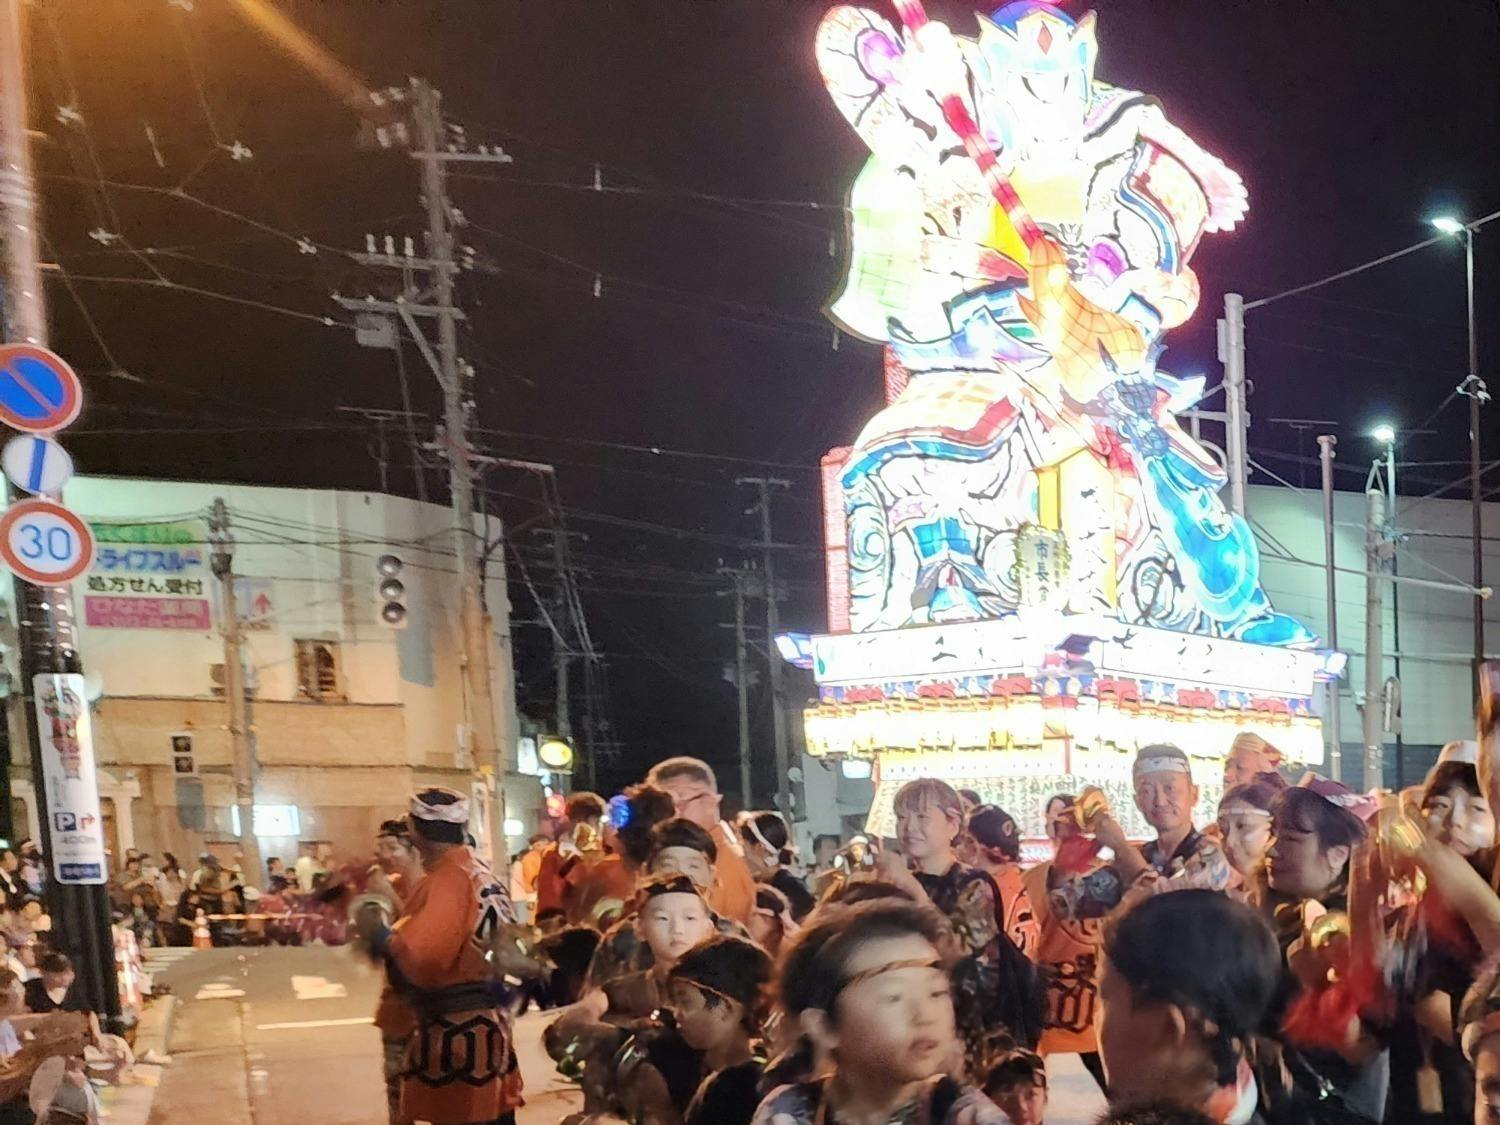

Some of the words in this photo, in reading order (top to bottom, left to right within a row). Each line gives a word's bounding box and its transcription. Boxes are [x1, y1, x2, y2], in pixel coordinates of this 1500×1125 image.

[20, 524, 71, 561] 30
[88, 576, 203, 595] 処方せん受付
